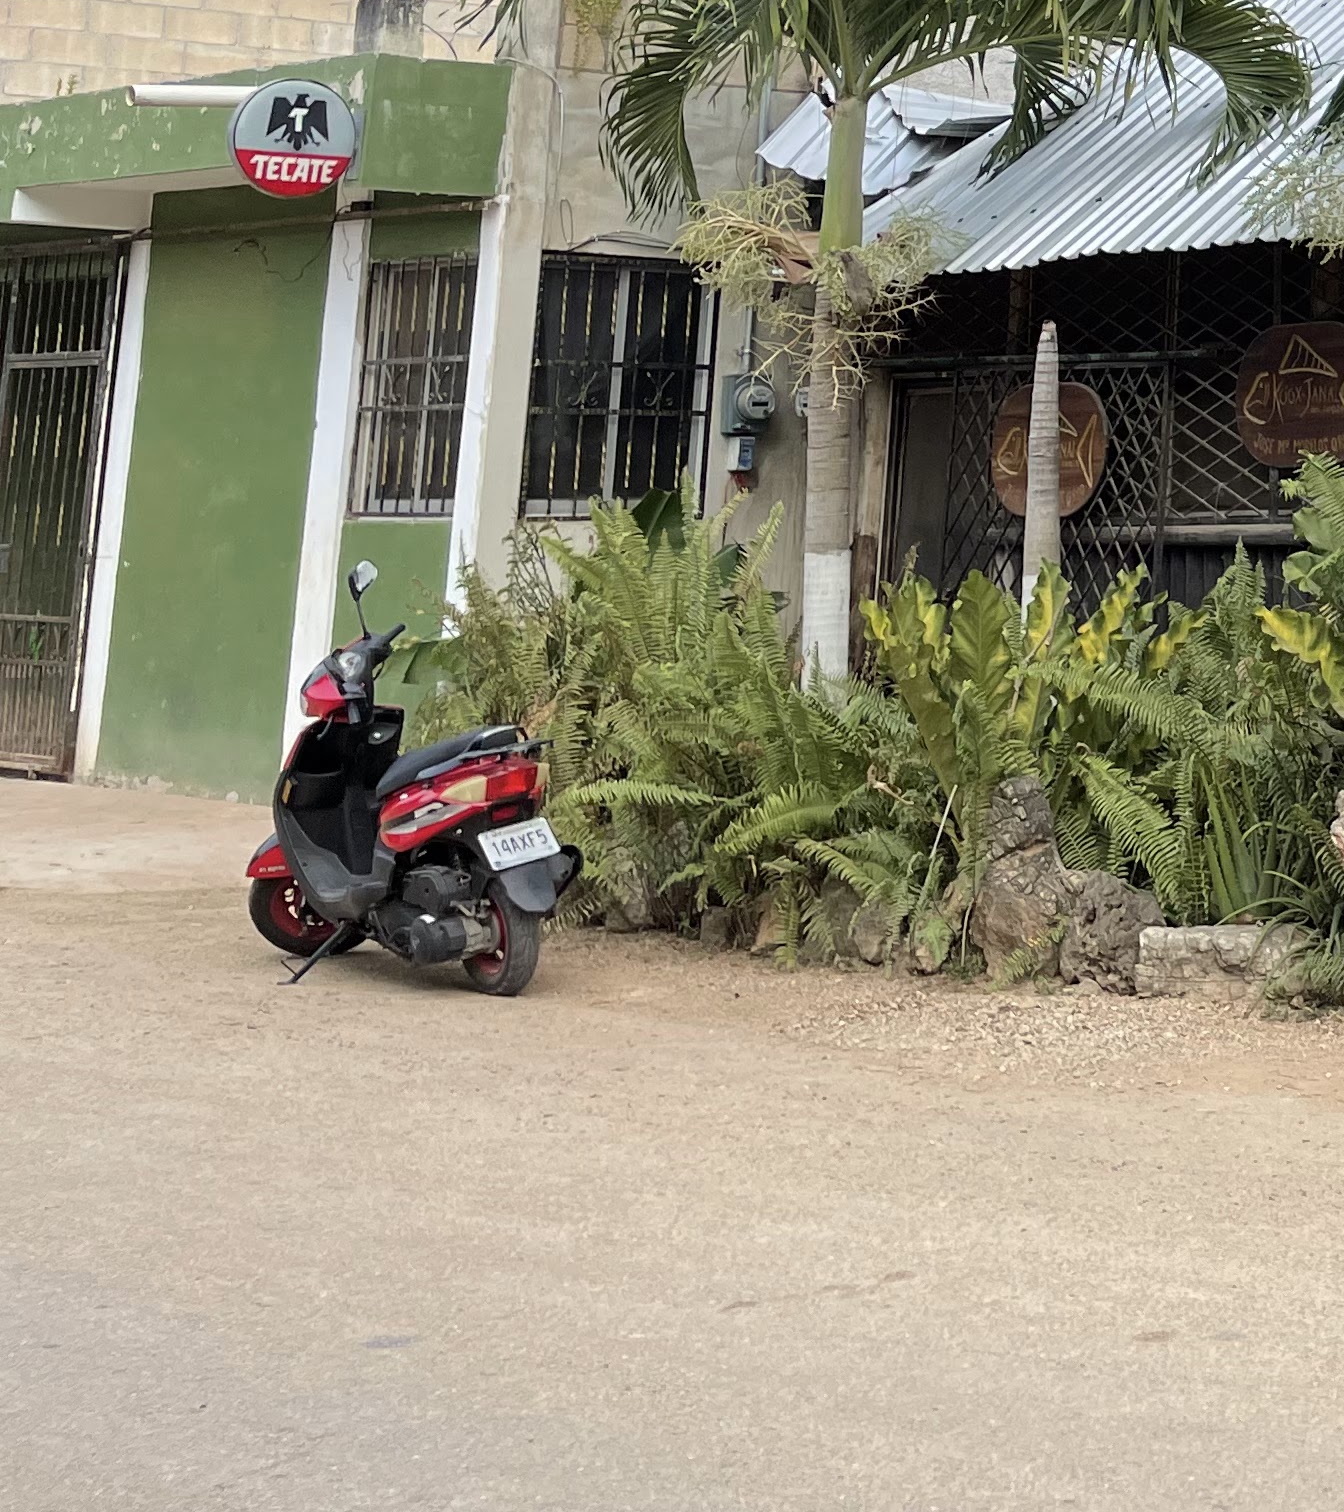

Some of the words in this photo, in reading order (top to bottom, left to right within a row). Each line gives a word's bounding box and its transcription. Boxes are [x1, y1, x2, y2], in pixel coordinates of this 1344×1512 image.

[288, 107, 309, 132] T
[249, 153, 338, 184] TECATE
[491, 828, 548, 857] 14AXF5
